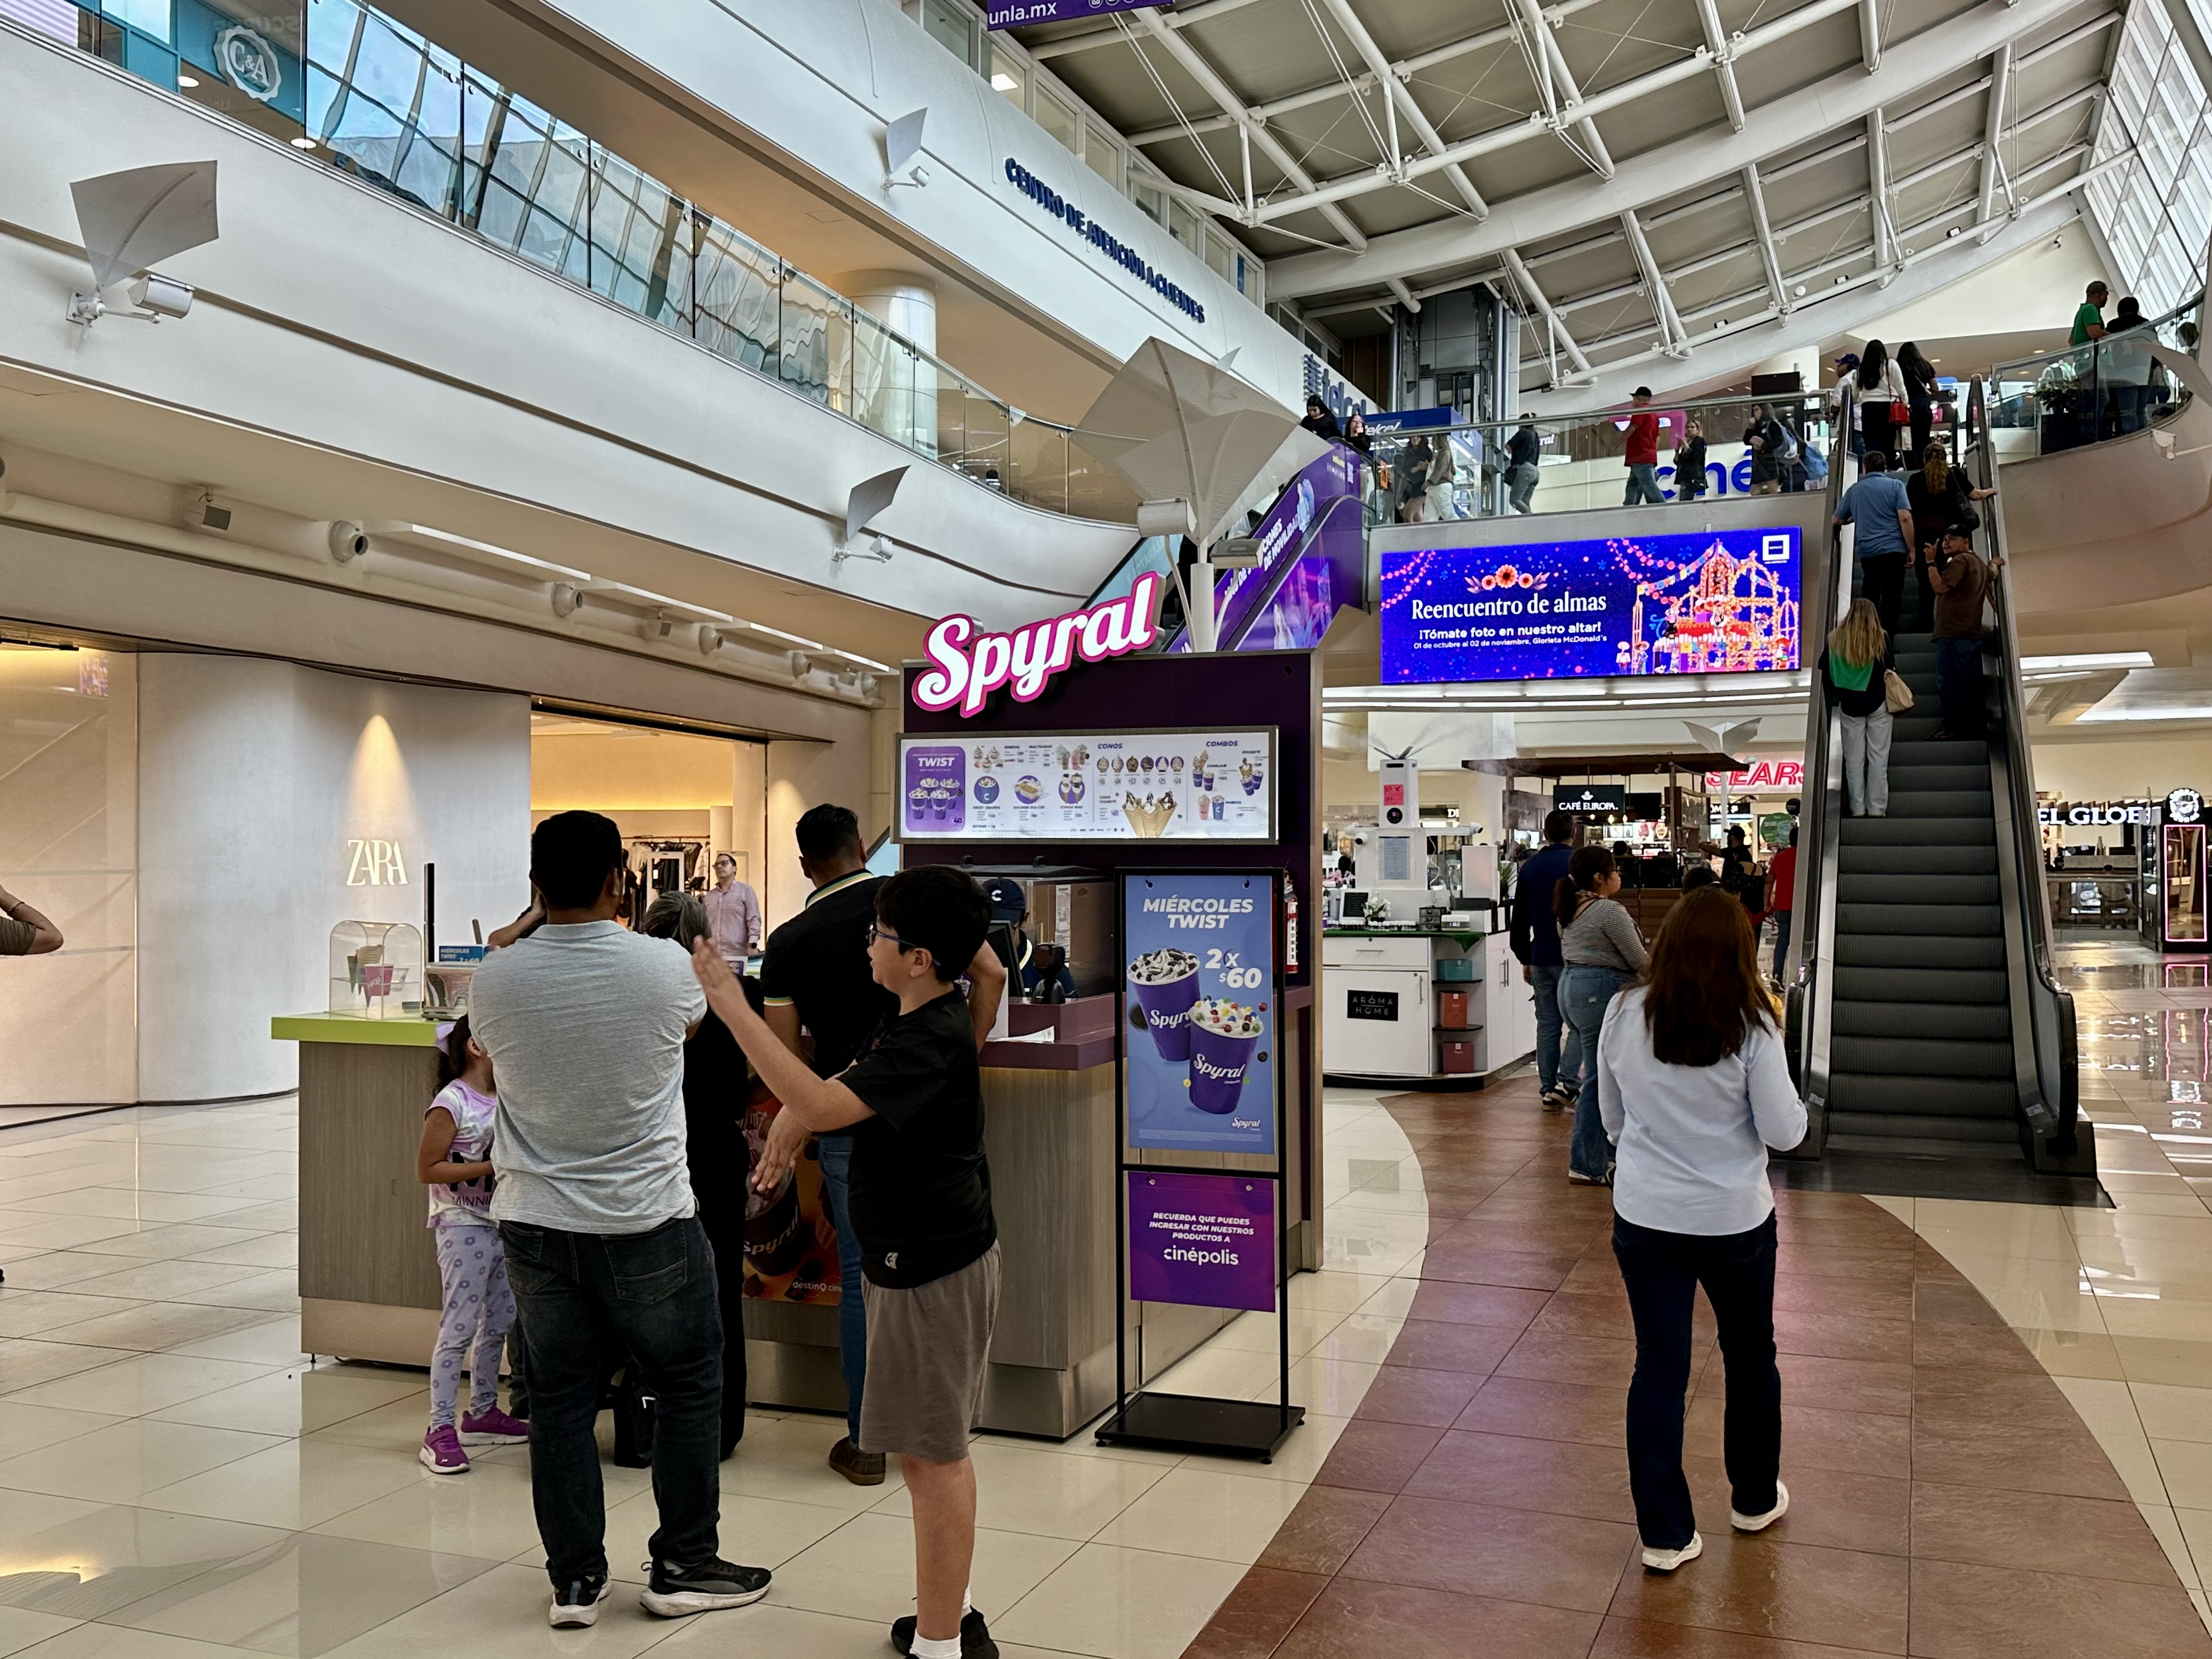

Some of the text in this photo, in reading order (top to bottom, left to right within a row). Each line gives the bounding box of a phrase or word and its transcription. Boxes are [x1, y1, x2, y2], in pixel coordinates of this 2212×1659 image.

[989, 2, 1057, 25] unla.mx
[230, 41, 270, 87] C&A
[1005, 157, 1205, 324] CENTRO DE ATENCIÓN A CLIENTES
[1539, 433, 1555, 446] ral
[1656, 449, 1752, 499] cné
[1262, 518, 1283, 552] CIONES
[1263, 556, 1272, 572] DE
[1412, 591, 1606, 619] Reencuentro de almas
[1419, 622, 1601, 640] ¡Tómate foto en nuestro altar!
[1563, 635, 1607, 643] McDonald's
[914, 573, 1155, 715] Spyral
[918, 758, 955, 767] TWIST
[1706, 762, 1804, 786] SEAR
[1559, 801, 1581, 810] CAFÉ
[2037, 808, 2066, 825] EL
[346, 839, 408, 886] ZARA
[1143, 895, 1253, 913] MIÉRCOLES
[1167, 915, 1228, 929] TWIST
[1218, 968, 1262, 989] $60
[1352, 995, 1393, 1006] AROMA
[1356, 1007, 1389, 1015] HOME
[1194, 1053, 1245, 1079] Spyral
[1232, 1116, 1261, 1129] Spyral
[452, 1195, 492, 1206] MINNI
[1153, 1212, 1250, 1225] RECUERDA QUE PUEDES
[1149, 1221, 1189, 1231] INGRESAR
[1211, 1225, 1254, 1235] NUESTROS
[1172, 1232, 1222, 1242] PRODUCTOS
[1163, 1245, 1239, 1265] cinépolis
